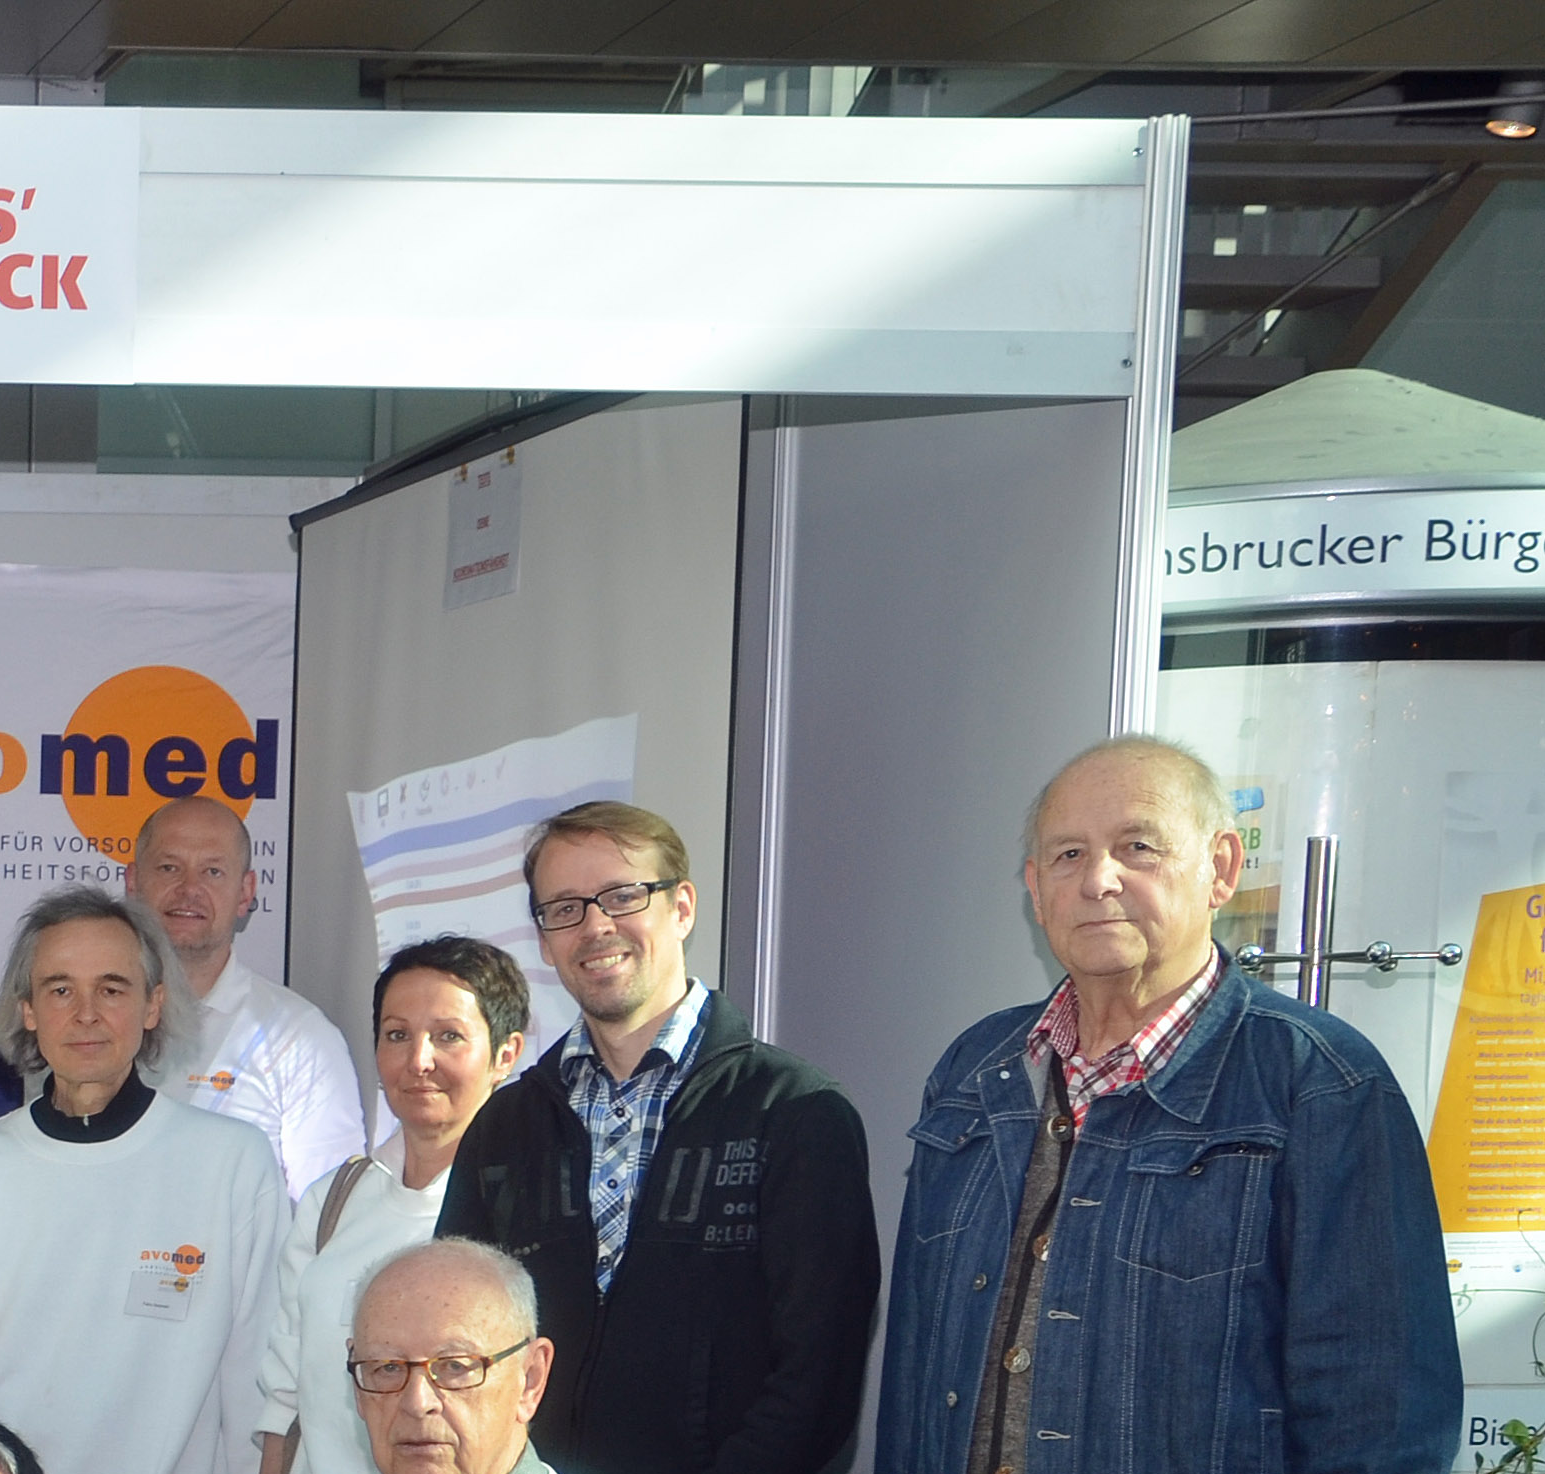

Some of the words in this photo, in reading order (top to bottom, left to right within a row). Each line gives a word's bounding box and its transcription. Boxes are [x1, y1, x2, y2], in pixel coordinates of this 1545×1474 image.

[1424, 518, 1545, 574] Bürg
[1, 830, 43, 852] FÜR
[723, 1137, 758, 1161] THIS
[140, 1249, 206, 1265] avomed
[1468, 1416, 1537, 1447] Bite
